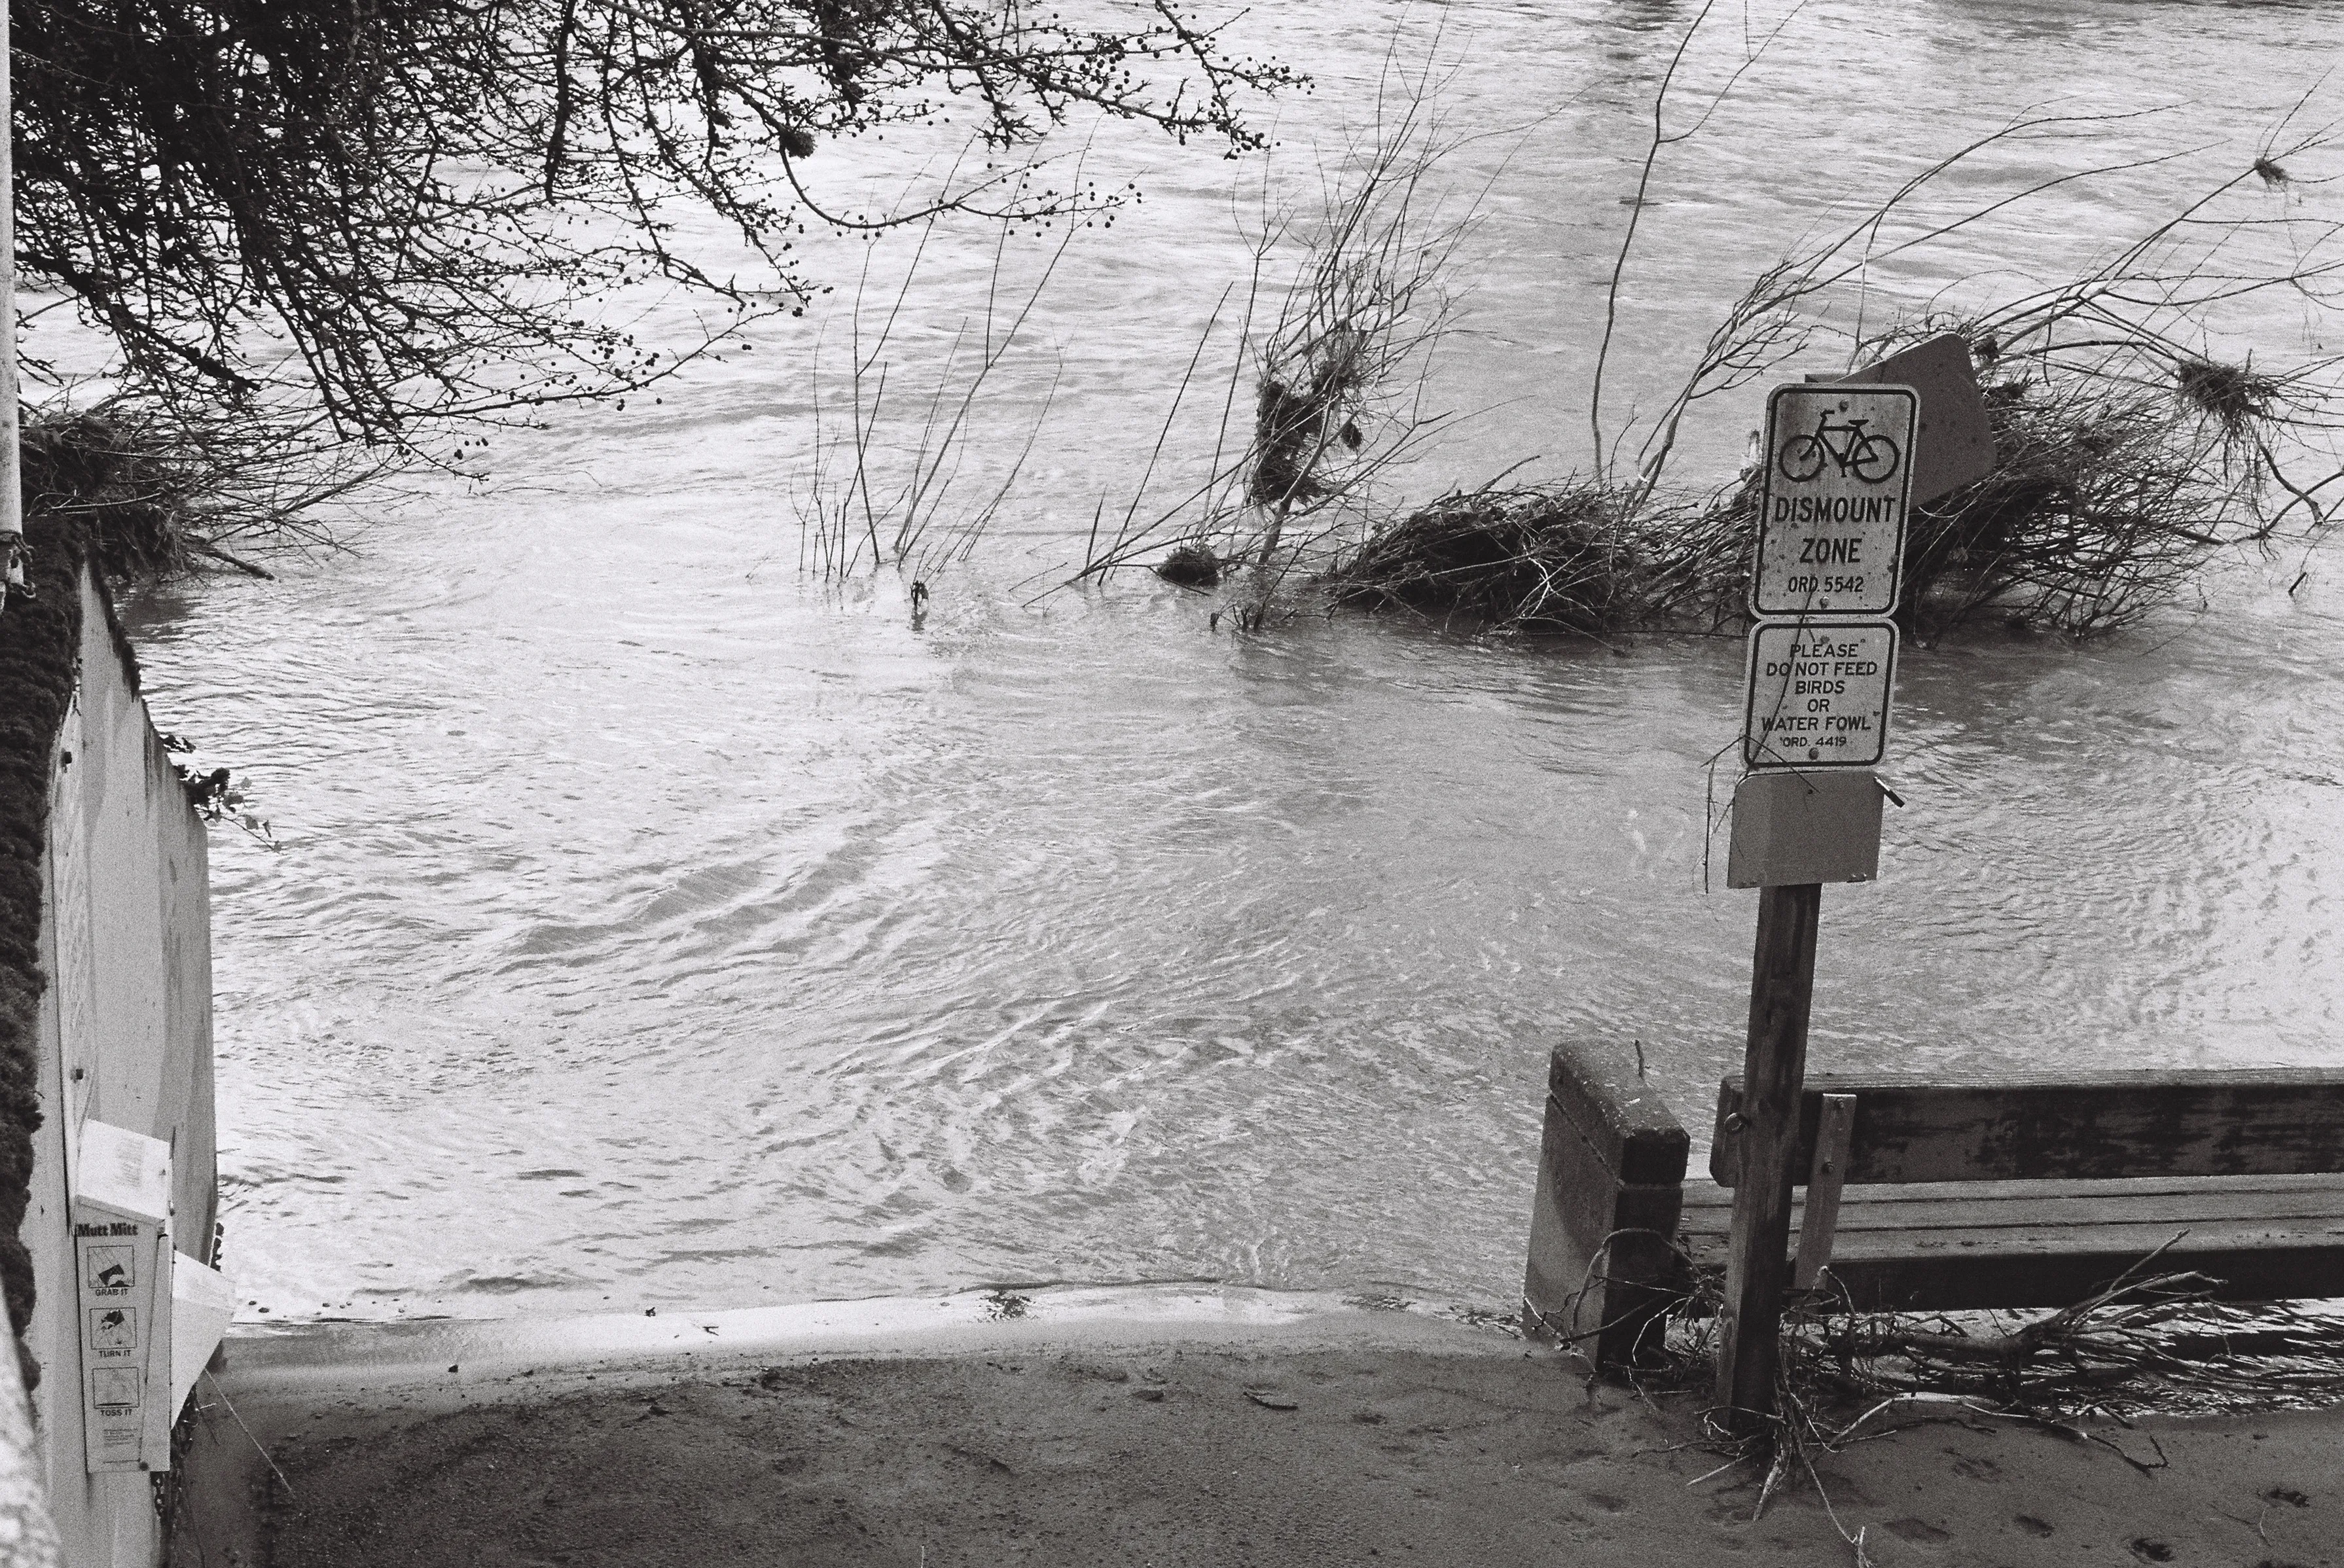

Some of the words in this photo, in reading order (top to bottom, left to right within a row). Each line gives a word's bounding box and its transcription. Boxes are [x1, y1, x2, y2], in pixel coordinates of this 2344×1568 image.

[1775, 497, 1896, 522] DISMOUNT
[1800, 538, 1862, 563] ZONE
[1824, 577, 1864, 592] 5542
[1790, 643, 1858, 658] PLEASE
[1767, 662, 1790, 676] DO
[1795, 662, 1829, 676] NOT
[1834, 662, 1877, 676] FEED
[1795, 680, 1845, 694] BIRDS
[1807, 698, 1830, 712] OR
[1761, 717, 1818, 732] WATER
[1825, 716, 1871, 731] FOWL
[1815, 736, 1847, 747] 4419
[77, 1223, 108, 1237] Mutt
[110, 1222, 138, 1236] Mitt
